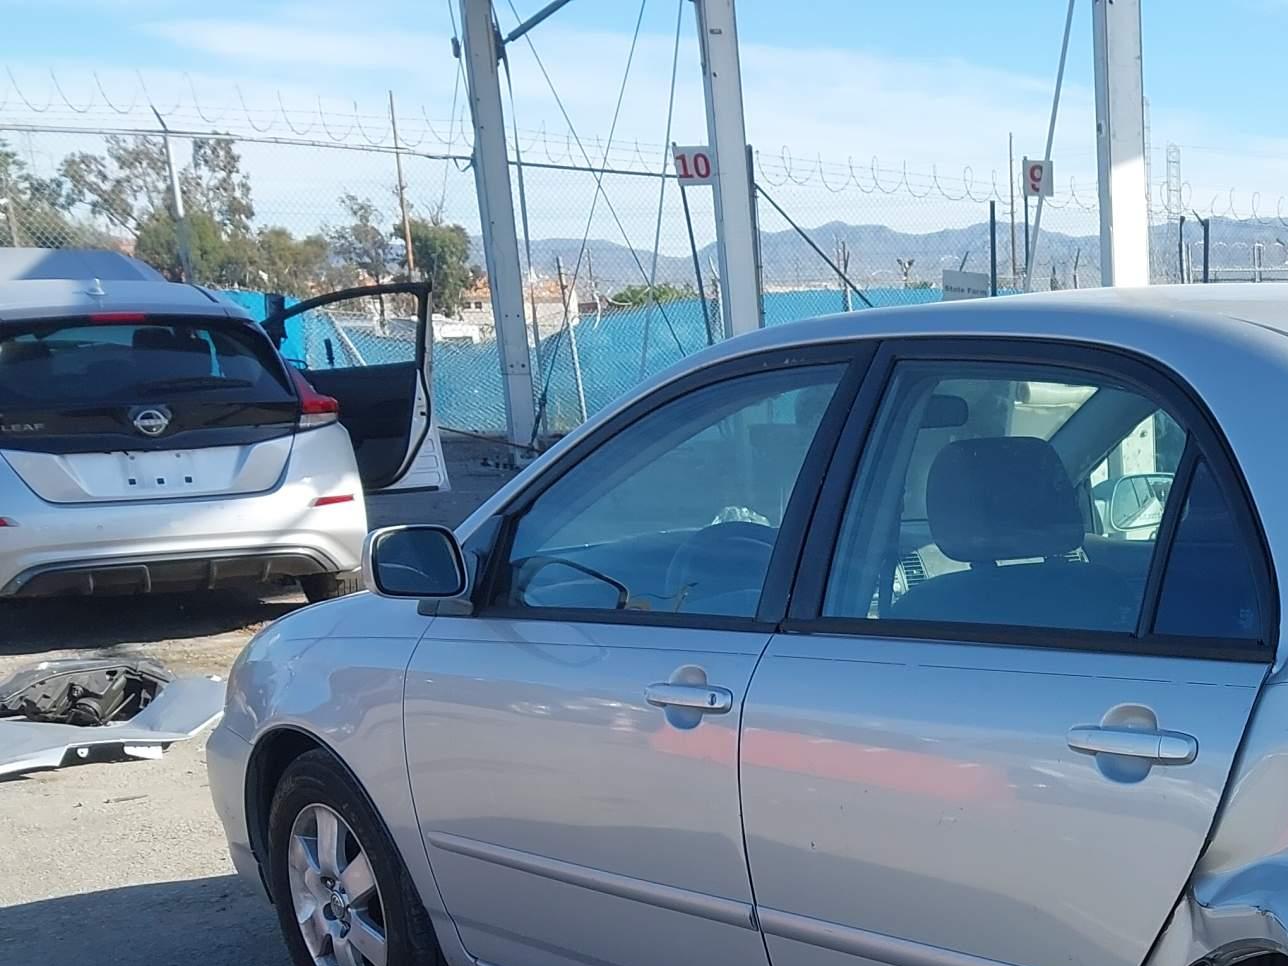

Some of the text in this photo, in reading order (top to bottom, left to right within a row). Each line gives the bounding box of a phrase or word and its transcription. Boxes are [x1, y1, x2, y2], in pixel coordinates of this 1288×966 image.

[675, 153, 711, 178] 10
[1030, 164, 1043, 193] 9
[1, 423, 45, 432] LEAF
